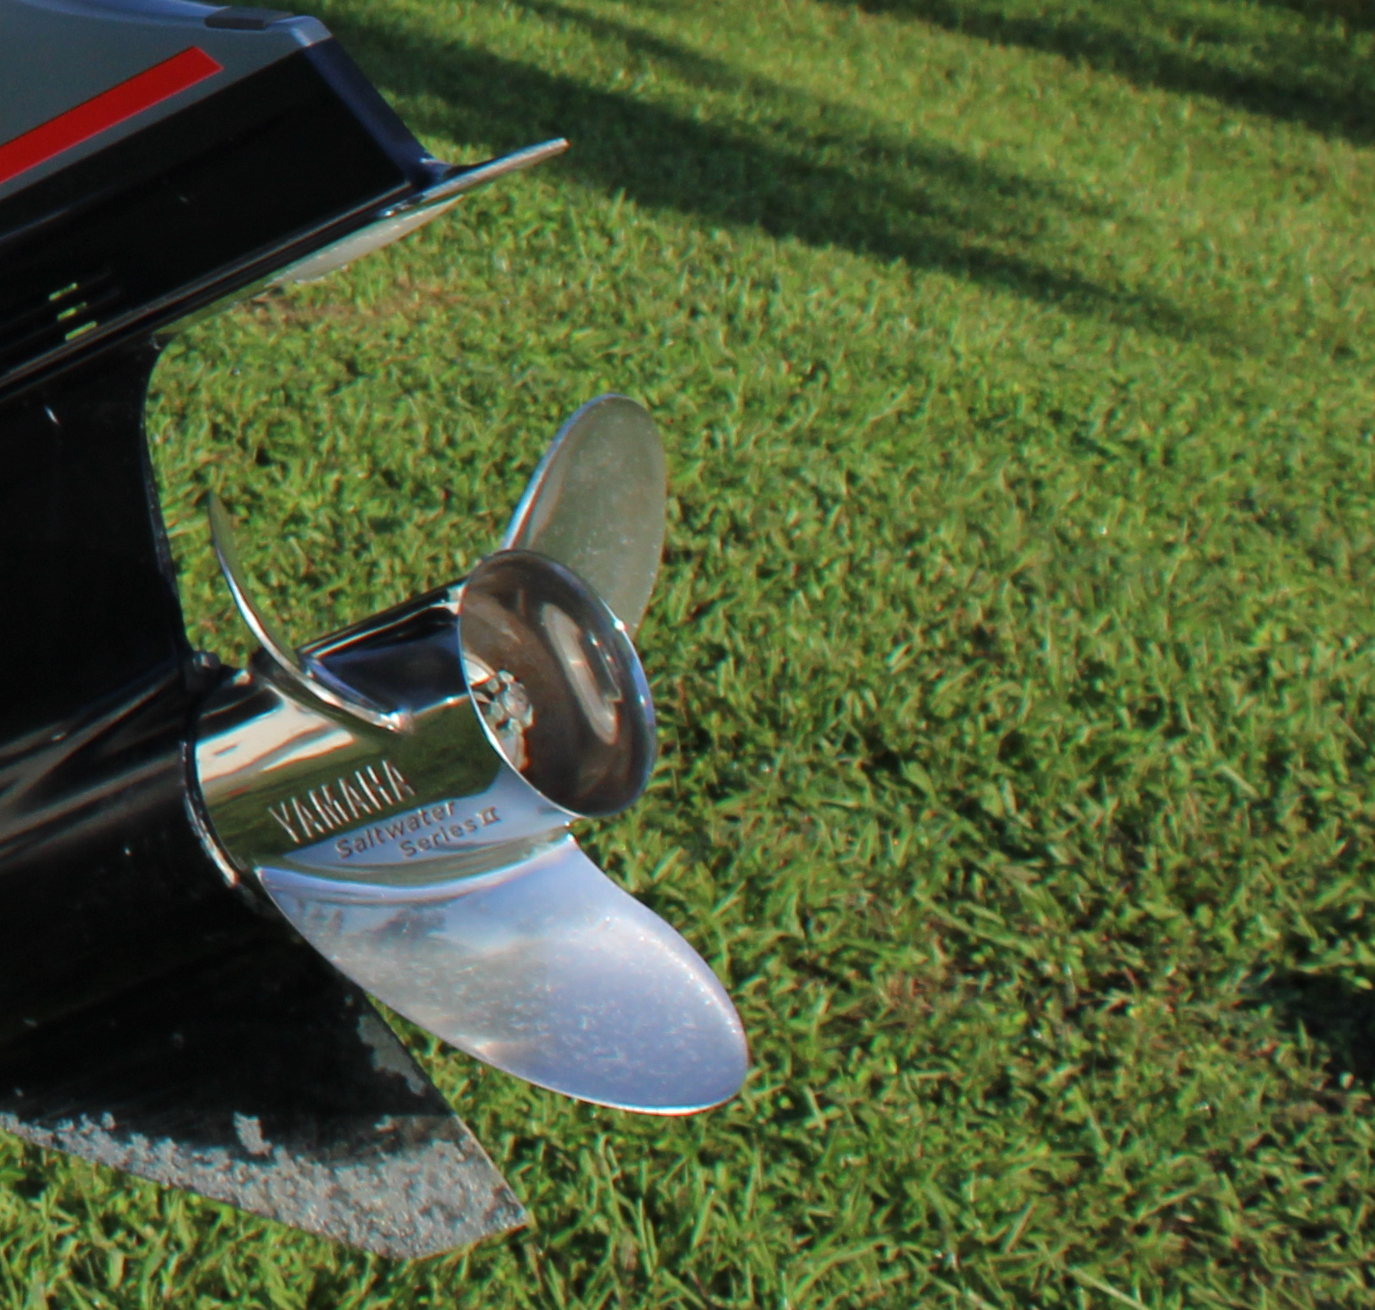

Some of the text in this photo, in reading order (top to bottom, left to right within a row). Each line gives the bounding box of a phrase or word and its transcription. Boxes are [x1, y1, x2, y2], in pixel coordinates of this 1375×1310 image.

[269, 760, 416, 843] YAMAHA
[335, 801, 457, 860] Saltwater
[400, 818, 478, 857] Series
